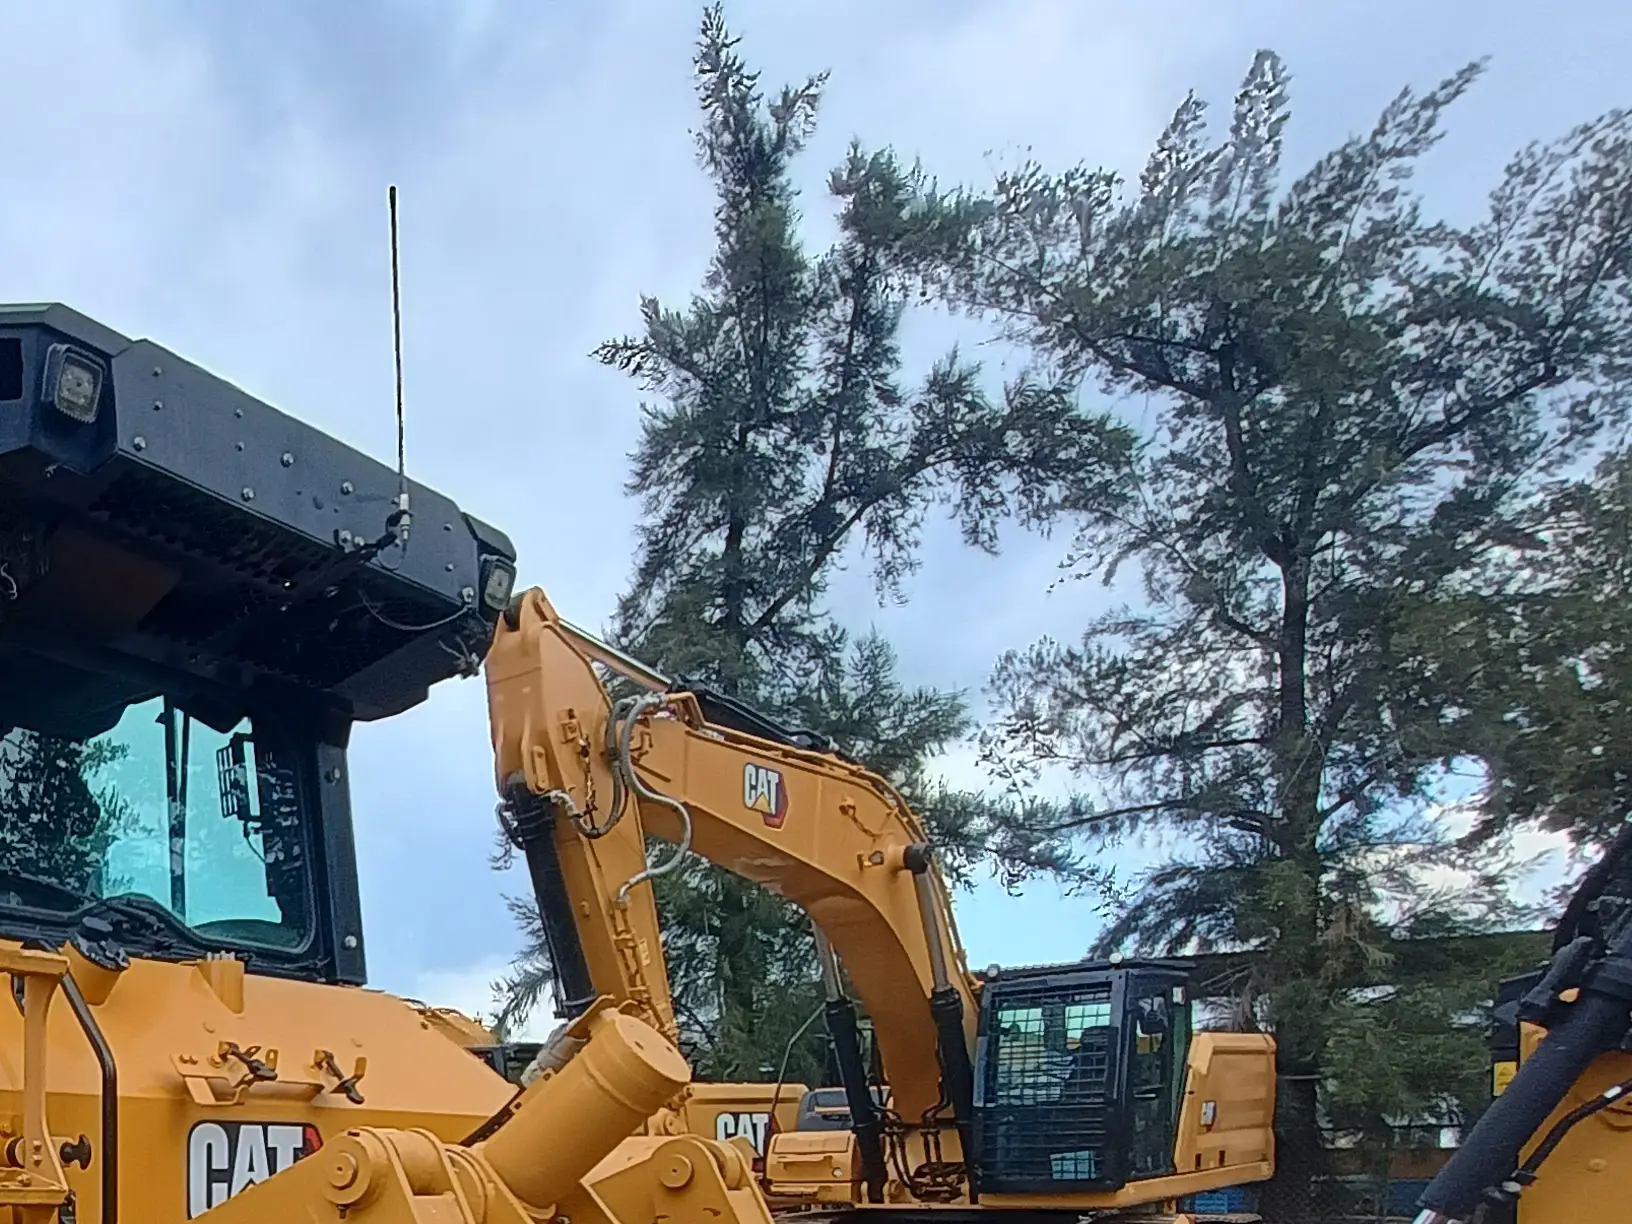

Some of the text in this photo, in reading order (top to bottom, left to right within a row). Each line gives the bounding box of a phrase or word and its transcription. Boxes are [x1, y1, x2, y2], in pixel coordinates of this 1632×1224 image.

[745, 765, 779, 815] CAT
[717, 1112, 769, 1157] CAT
[190, 1123, 303, 1219] CAT
